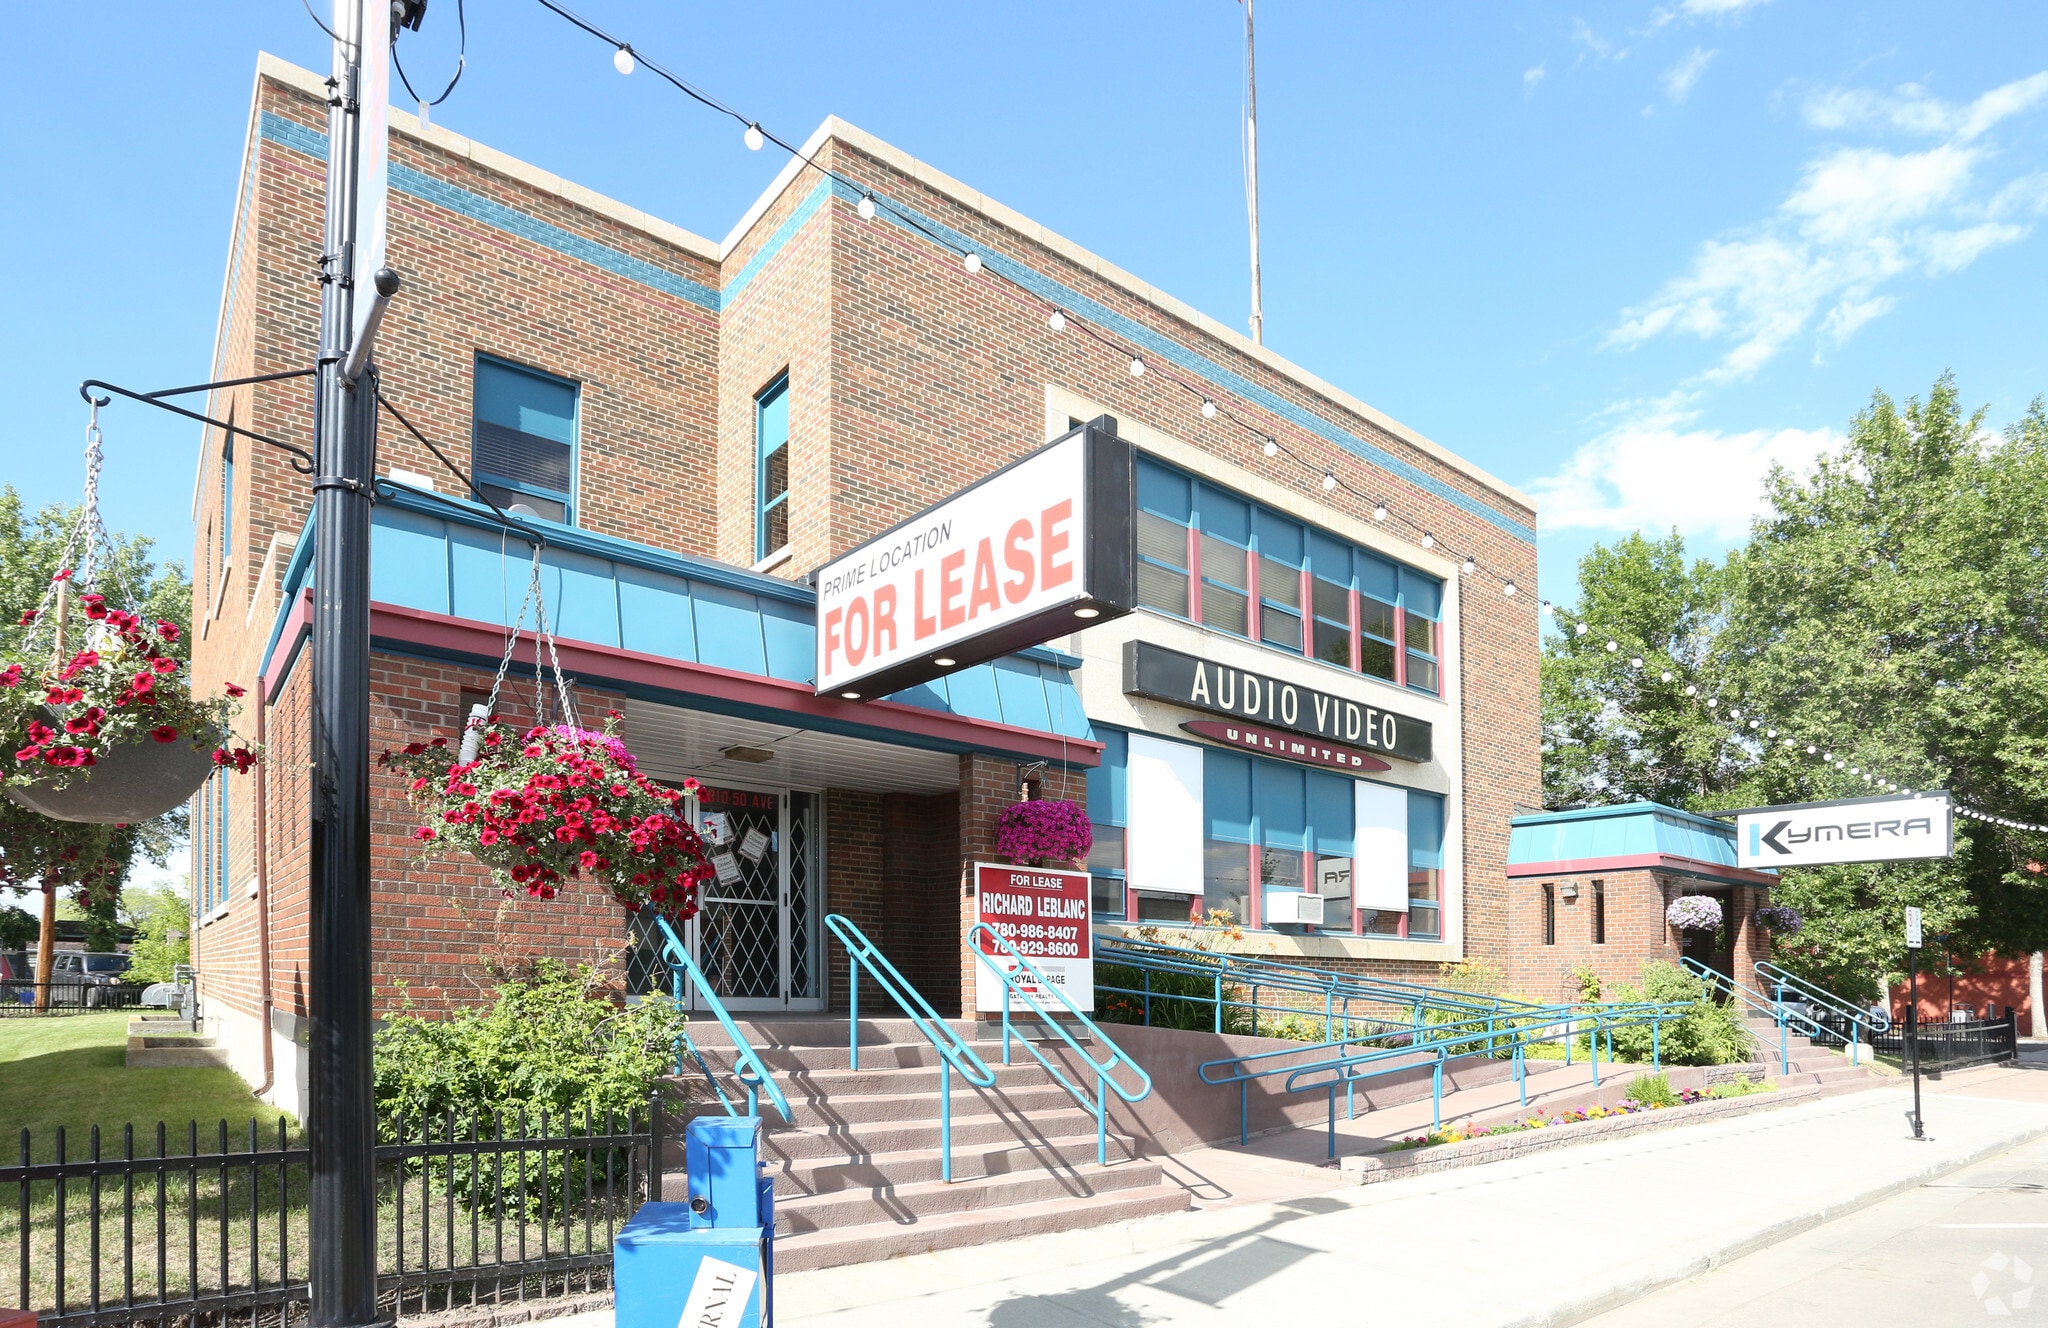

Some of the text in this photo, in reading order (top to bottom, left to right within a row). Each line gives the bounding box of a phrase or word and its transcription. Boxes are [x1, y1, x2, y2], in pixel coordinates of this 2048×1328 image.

[823, 519, 953, 601] PRIME LOCATION
[824, 497, 1073, 677] FOR LEASE
[1190, 660, 1397, 750] AUDIO VIDEO
[1226, 728, 1362, 767] UNLIMITED
[1749, 817, 1931, 856] KYMERA
[1010, 874, 1063, 889] FOR LEASE
[982, 892, 1086, 920] RICHARD LEBLANC
[991, 922, 1078, 940] 780-986-8407
[697, 1273, 737, 1328] RNAL
